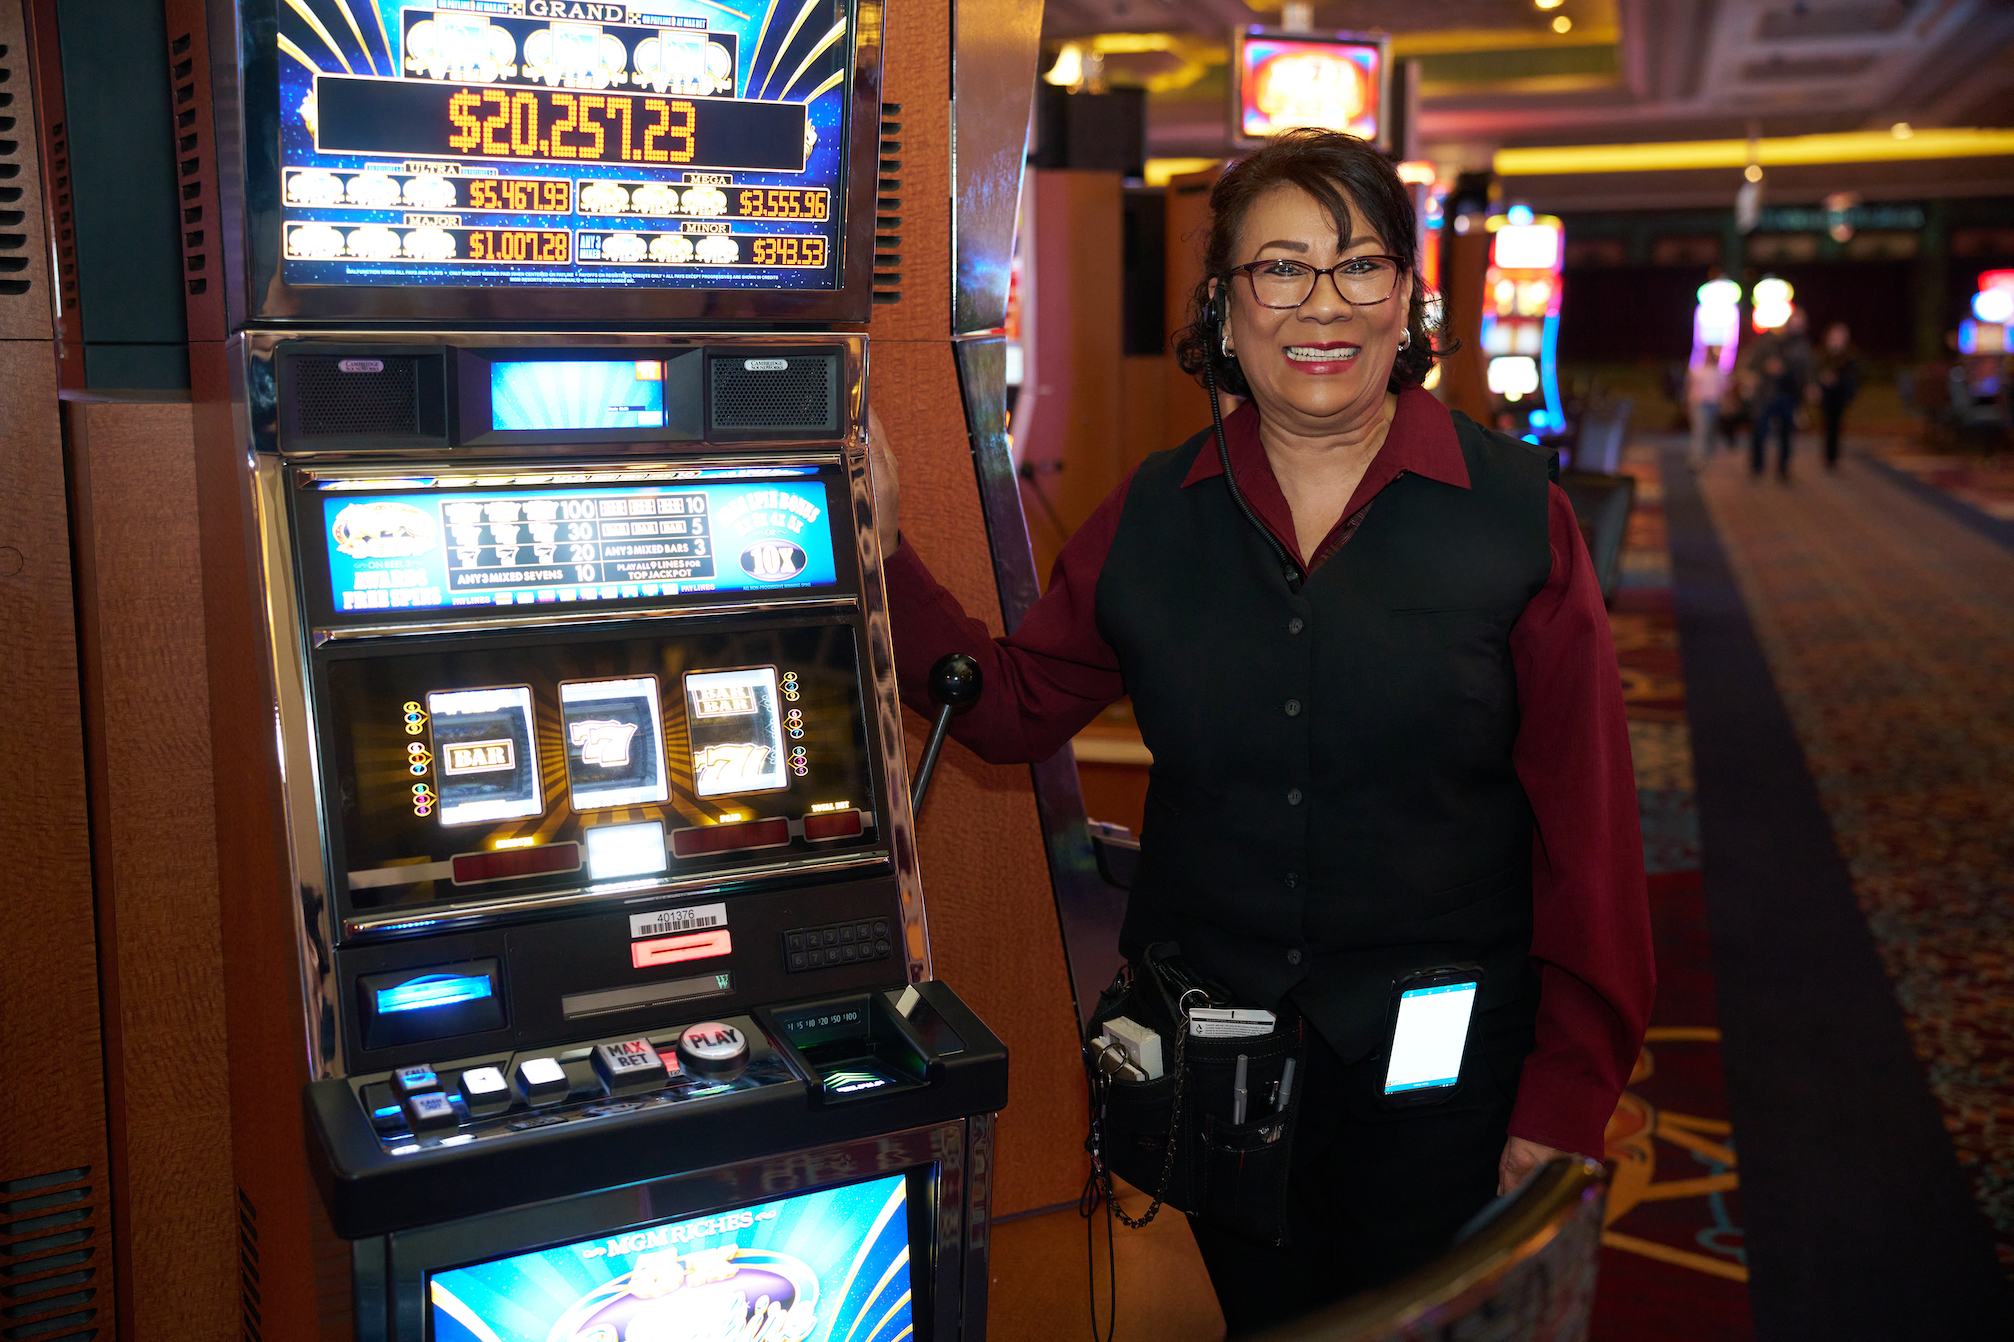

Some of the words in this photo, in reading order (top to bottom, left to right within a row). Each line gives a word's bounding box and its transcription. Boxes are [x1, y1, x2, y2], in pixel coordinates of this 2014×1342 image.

[529, 0, 623, 22] GRAND
[651, 15, 672, 26] PAYLINE
[676, 17, 683, 27] AT
[684, 18, 696, 28] MAX
[695, 19, 706, 29] BET
[649, 71, 714, 96] WILD
[449, 88, 696, 163] $20,257.23
[410, 163, 457, 175] ULTRA
[691, 175, 727, 185] MEGA
[469, 180, 568, 211] $5,467.93
[739, 190, 827, 218] $3,555.96
[409, 216, 458, 227] MAJOR
[686, 223, 727, 233] MINOR
[469, 231, 568, 261] $1,007.28
[580, 236, 594, 249] ANY
[580, 249, 602, 259] MIXED
[752, 238, 824, 265] $343.53
[561, 500, 595, 520] 100
[686, 497, 705, 514] 10
[779, 492, 821, 523] BONUS
[568, 522, 593, 541] 30
[692, 518, 703, 535] 5
[569, 543, 595, 562] 20
[605, 546, 627, 556] ANY
[627, 545, 634, 556] 3
[634, 544, 663, 555] MIXED
[664, 543, 689, 554] BARS
[694, 538, 706, 555] 3
[368, 561, 383, 569] ON
[385, 560, 404, 568] REEL
[406, 560, 411, 568] 3
[617, 562, 637, 572] PLAY
[636, 562, 651, 570] ALL
[650, 561, 658, 570] 9
[657, 559, 685, 569] LINES
[685, 560, 701, 568] FOR
[750, 544, 796, 575] 10X
[457, 574, 482, 585] ANY
[482, 573, 490, 584] 3
[489, 572, 523, 583] MIXED
[523, 569, 564, 582] SEVENS
[575, 564, 595, 582] 10
[627, 571, 648, 580] TOP
[647, 569, 692, 579] JACKPOT
[681, 583, 716, 592] PAYLINES
[451, 596, 490, 606] PAYLINES
[700, 686, 746, 700] BAR
[703, 698, 748, 713] BAR
[454, 747, 506, 768] BAR
[811, 803, 835, 812] TOTAL
[835, 800, 849, 809] BET
[720, 813, 742, 823] PAID
[657, 909, 695, 923] 401376
[793, 937, 799, 946] 1
[810, 935, 817, 944] 2
[827, 933, 834, 941] 3
[843, 930, 850, 938] 4
[861, 928, 867, 936] 5
[795, 956, 802, 965] 6
[813, 954, 819, 962] 7
[829, 951, 836, 960] 8
[846, 948, 853, 957] 9
[863, 946, 869, 954] 0
[787, 1022, 794, 1031] $1
[796, 1021, 803, 1030] $5
[805, 1019, 816, 1028] $10
[817, 1016, 829, 1026] $20
[830, 1014, 841, 1024] $50
[842, 1012, 857, 1021] $100
[688, 1027, 738, 1049] PLAY
[607, 1041, 646, 1057] MAX
[617, 1053, 649, 1067] BET
[606, 1229, 669, 1258] MGM
[671, 1211, 753, 1244] RICHES
